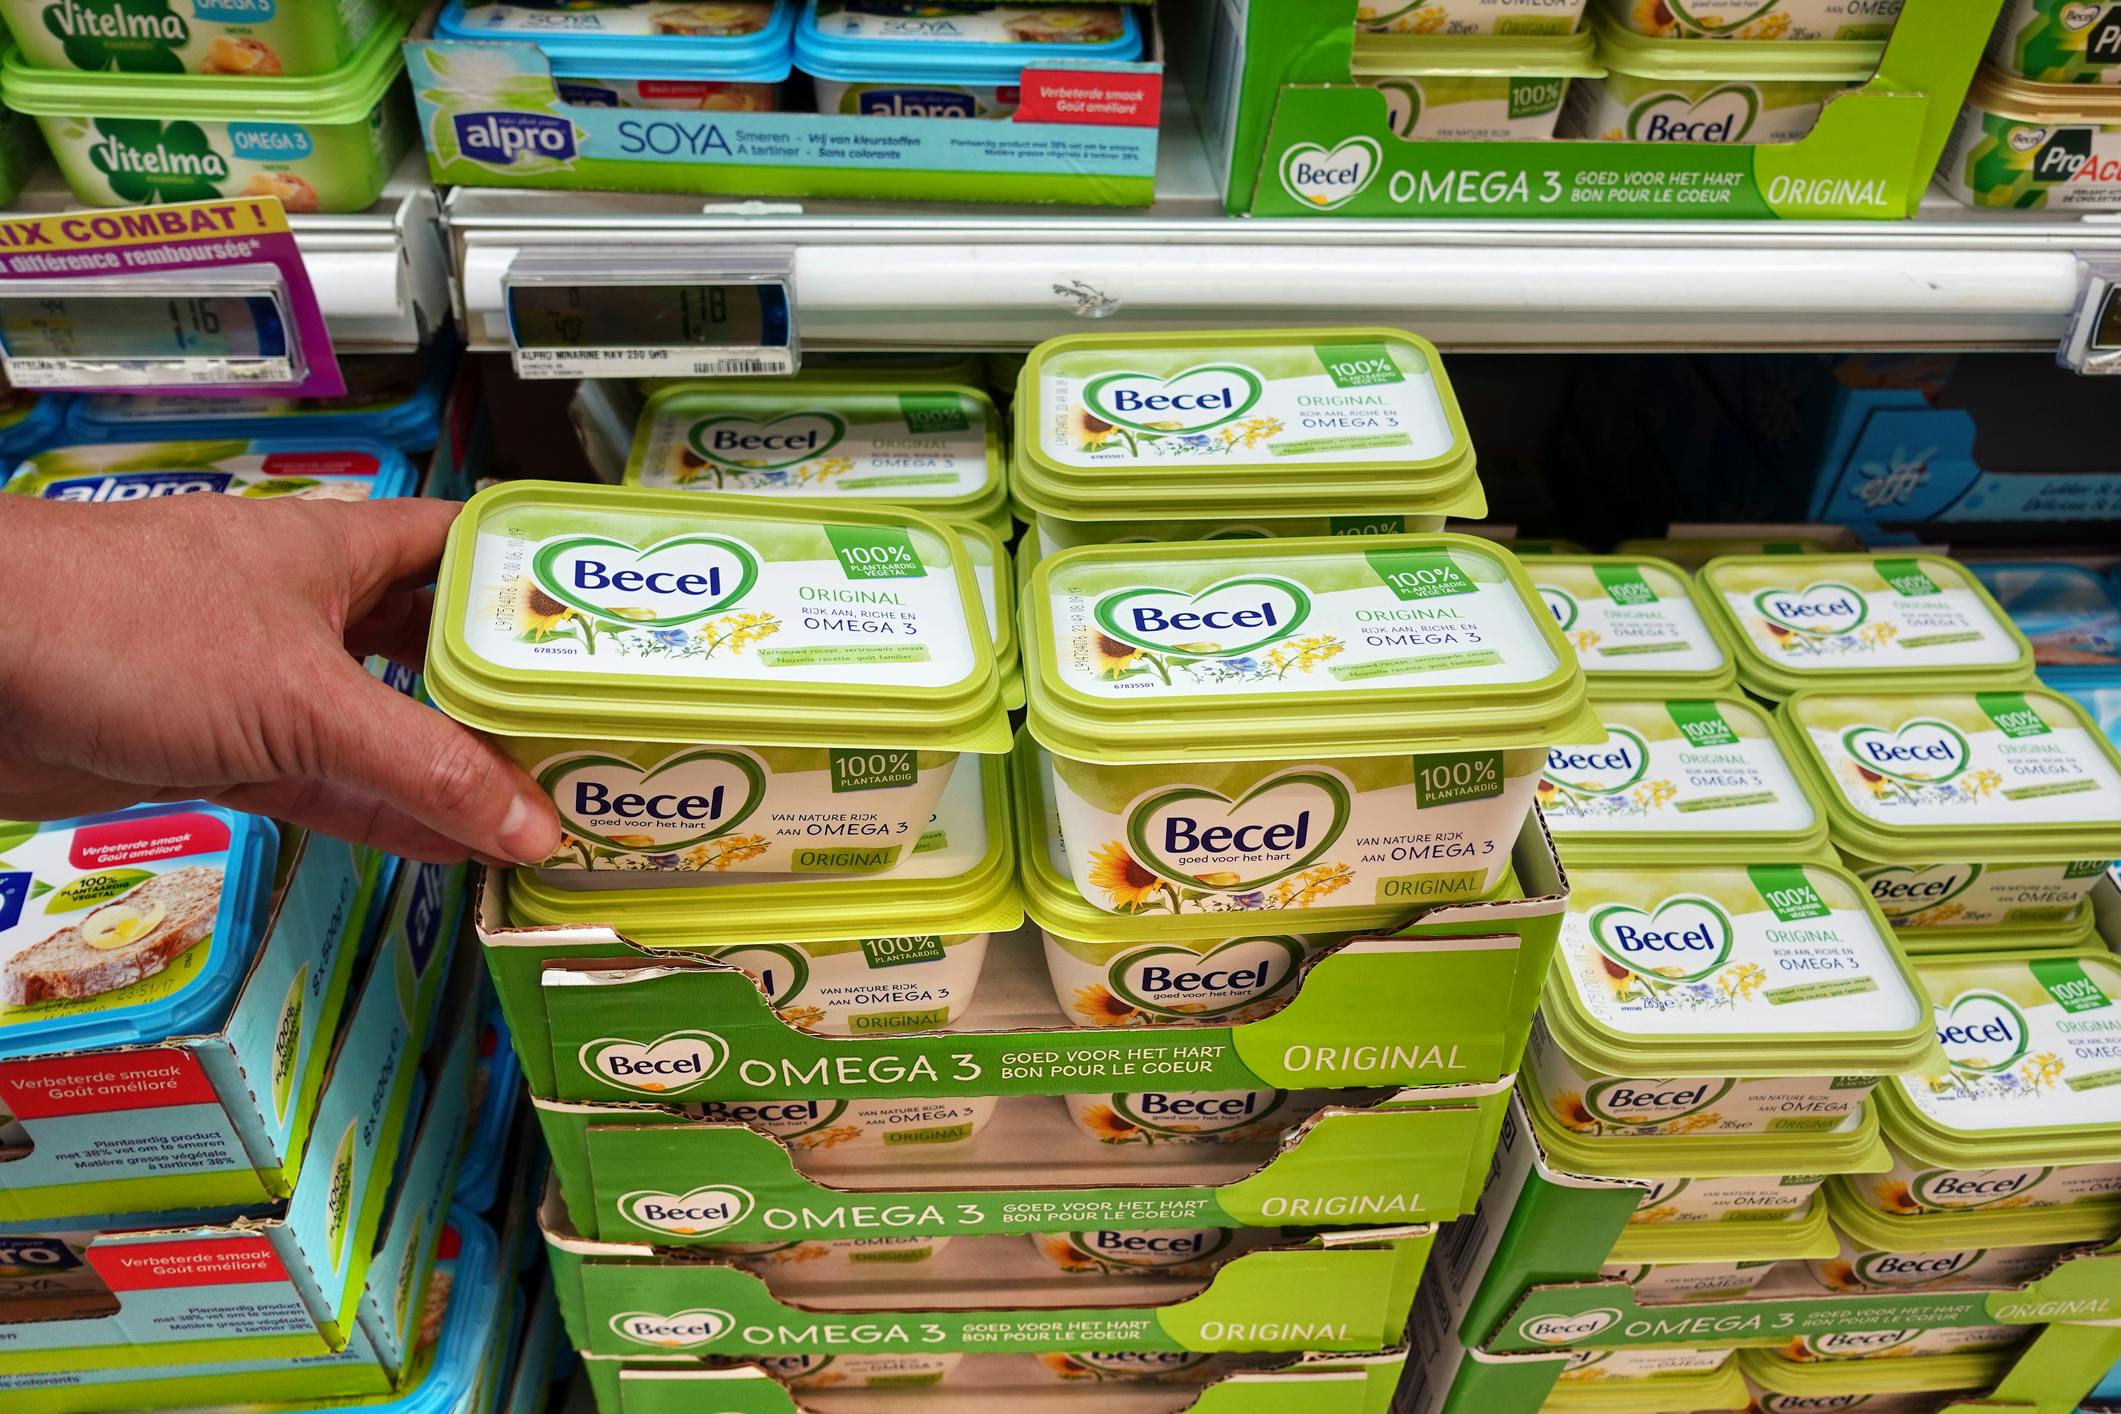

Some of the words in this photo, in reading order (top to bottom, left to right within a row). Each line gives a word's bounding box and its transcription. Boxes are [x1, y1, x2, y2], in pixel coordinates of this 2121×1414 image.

[53, 4, 186, 40] Vitelma
[1040, 86, 1100, 100] Verbeterde
[1103, 88, 1144, 102] smaak
[1512, 84, 1559, 107] 100%
[1087, 102, 1137, 114] amélioré
[235, 131, 292, 150] OMEGA
[293, 133, 308, 150] 3
[466, 115, 566, 158] alpro
[618, 121, 732, 156] SOYA
[736, 131, 790, 143] Smeren
[808, 134, 827, 147] Vrij
[831, 137, 850, 145] van
[854, 135, 921, 147] kleurstoffen
[99, 136, 226, 177] Vitelma
[751, 146, 799, 157] tartiner
[819, 148, 845, 159] Sans
[849, 149, 901, 160] colorants
[1297, 161, 1358, 185] Becel
[1575, 171, 1618, 186] GOED
[1623, 172, 1665, 186] VOOR
[1669, 172, 1702, 186] HET
[1703, 172, 1745, 187] HART
[1389, 171, 1529, 203] OMEGA
[1539, 171, 1563, 203] 3
[1571, 187, 1602, 202] BON
[1608, 188, 1649, 202] POUR
[1654, 188, 1673, 203] LE
[1678, 187, 1732, 203] COEUR
[1767, 175, 1889, 206] ORIGINAL
[61, 207, 237, 243] COMBAT
[254, 204, 266, 228] !
[10, 251, 120, 274] différence
[1330, 358, 1391, 377] 100%
[1114, 387, 1233, 412] Becel
[1297, 395, 1391, 407] ORIGINAL
[1302, 418, 1379, 428] OMEGA
[713, 430, 817, 451] Becel
[841, 546, 911, 564] 100%
[574, 559, 722, 596] Becel
[1387, 566, 1460, 589] 100%
[799, 586, 908, 606] ORIGINAL
[801, 607, 828, 616] RIJK
[831, 609, 857, 618] AAN,
[861, 611, 897, 619] RICHE
[900, 612, 916, 620] EN
[1132, 602, 1278, 632] Becel
[1355, 608, 1466, 622] ORIGINAL
[1774, 598, 1854, 618] Becel
[804, 617, 895, 634] OMEGA
[902, 622, 917, 635] 3
[1366, 633, 1459, 647] OMEGA
[1464, 632, 1482, 643] 3
[1681, 718, 1729, 738] 100%
[1994, 710, 2039, 728] 100%
[1864, 739, 1955, 763] Becel
[836, 752, 910, 778] 100%
[1420, 758, 1496, 792] 100%
[841, 773, 912, 787] PLANTAARDIG
[575, 781, 725, 821] Becel
[1425, 782, 1498, 801] PLANTAARDIG
[772, 814, 795, 822] VAN
[798, 814, 847, 822] NATURE
[850, 813, 878, 821] RIJK
[776, 828, 801, 836] AAN
[806, 823, 890, 836] OMEGA
[896, 821, 909, 834] 3
[1164, 810, 1310, 854] Becel
[82, 840, 149, 857] Verbeterde
[150, 833, 192, 847] smaak
[1356, 837, 1380, 846] VAN
[1383, 833, 1432, 845] NATURE
[1435, 832, 1464, 841] RIJK
[97, 853, 128, 863] Goût
[129, 844, 183, 860] amélioré
[800, 851, 894, 867] ORIGINAL
[1361, 854, 1386, 863] AAN
[1391, 842, 1476, 861] OMEGA
[1482, 840, 1495, 854] 3
[61, 881, 130, 897] PLANTAARDIG
[79, 876, 118, 887] 100%
[1384, 876, 1478, 897] ORIGINAL
[1872, 875, 1957, 898] Becel
[1765, 886, 1818, 909] 100%
[1614, 923, 1714, 952] Becel
[1765, 929, 1845, 943] ORIGINAL
[866, 936, 935, 957] 100%
[875, 949, 940, 964] PLANTAARDIG
[1779, 958, 1845, 971] OMEGA
[1141, 960, 1270, 993] Becel
[855, 990, 932, 1005] OMEGA
[2050, 979, 2099, 1000] 100%
[856, 1014, 940, 1029] ORIGINAL
[610, 1052, 702, 1077] Becel
[1002, 1052, 1059, 1064] GOED
[1066, 1050, 1121, 1062] VOOR
[1128, 1048, 1168, 1060] HET
[1173, 1046, 1225, 1058] HART
[1284, 1044, 1467, 1072] ORIGINAL
[11, 1072, 115, 1091] Verbeterde
[119, 1066, 181, 1081] smaak
[738, 1055, 939, 1088] OMEGA
[952, 1053, 981, 1082] 3
[1002, 1067, 1043, 1079] BON
[1051, 1064, 1106, 1077] POUR
[1112, 1063, 1135, 1075] LE
[1142, 1061, 1213, 1074] COEUR
[48, 1086, 94, 1099] Goût
[97, 1078, 178, 1095] amélioré
[1608, 1084, 1709, 1108] Becel
[1140, 1094, 1255, 1115] Becel
[889, 1110, 958, 1124] OMEGA
[94, 1136, 169, 1149] Plantaardig
[171, 1131, 222, 1145] product
[55, 1151, 81, 1161] met
[84, 1150, 113, 1159] 38%
[113, 1147, 135, 1155] vet
[137, 1145, 158, 1154] om
[160, 1143, 174, 1151] te
[177, 1140, 225, 1149] smeren
[74, 1157, 125, 1169] Matière
[127, 1155, 169, 1166] grasse
[172, 1150, 227, 1161] végétale
[159, 1159, 205, 1170] tartiner
[207, 1157, 235, 1167] 38%
[1932, 1172, 2028, 1197] Becel
[645, 1203, 729, 1221] Becel
[1261, 1194, 1428, 1218] ORIGINAL
[763, 1206, 946, 1231] OMEGA
[958, 1205, 985, 1225] 3
[1097, 1231, 1202, 1253] Becel
[121, 1254, 213, 1268] Verbeterde
[216, 1250, 271, 1261] smaak
[152, 1264, 194, 1275] Goût
[197, 1261, 268, 1272] amélioré
[1874, 1253, 1963, 1276] Becel
[1994, 1299, 2113, 1319] ORIGINAL
[635, 1322, 712, 1337] Becel
[742, 1325, 909, 1345] OMEGA
[921, 1323, 947, 1343] 3
[1200, 1321, 1353, 1342] ORIGINAL
[1535, 1320, 1599, 1335] Becel
[1625, 1315, 1761, 1338] OMEGA
[1770, 1313, 1794, 1328] 3
